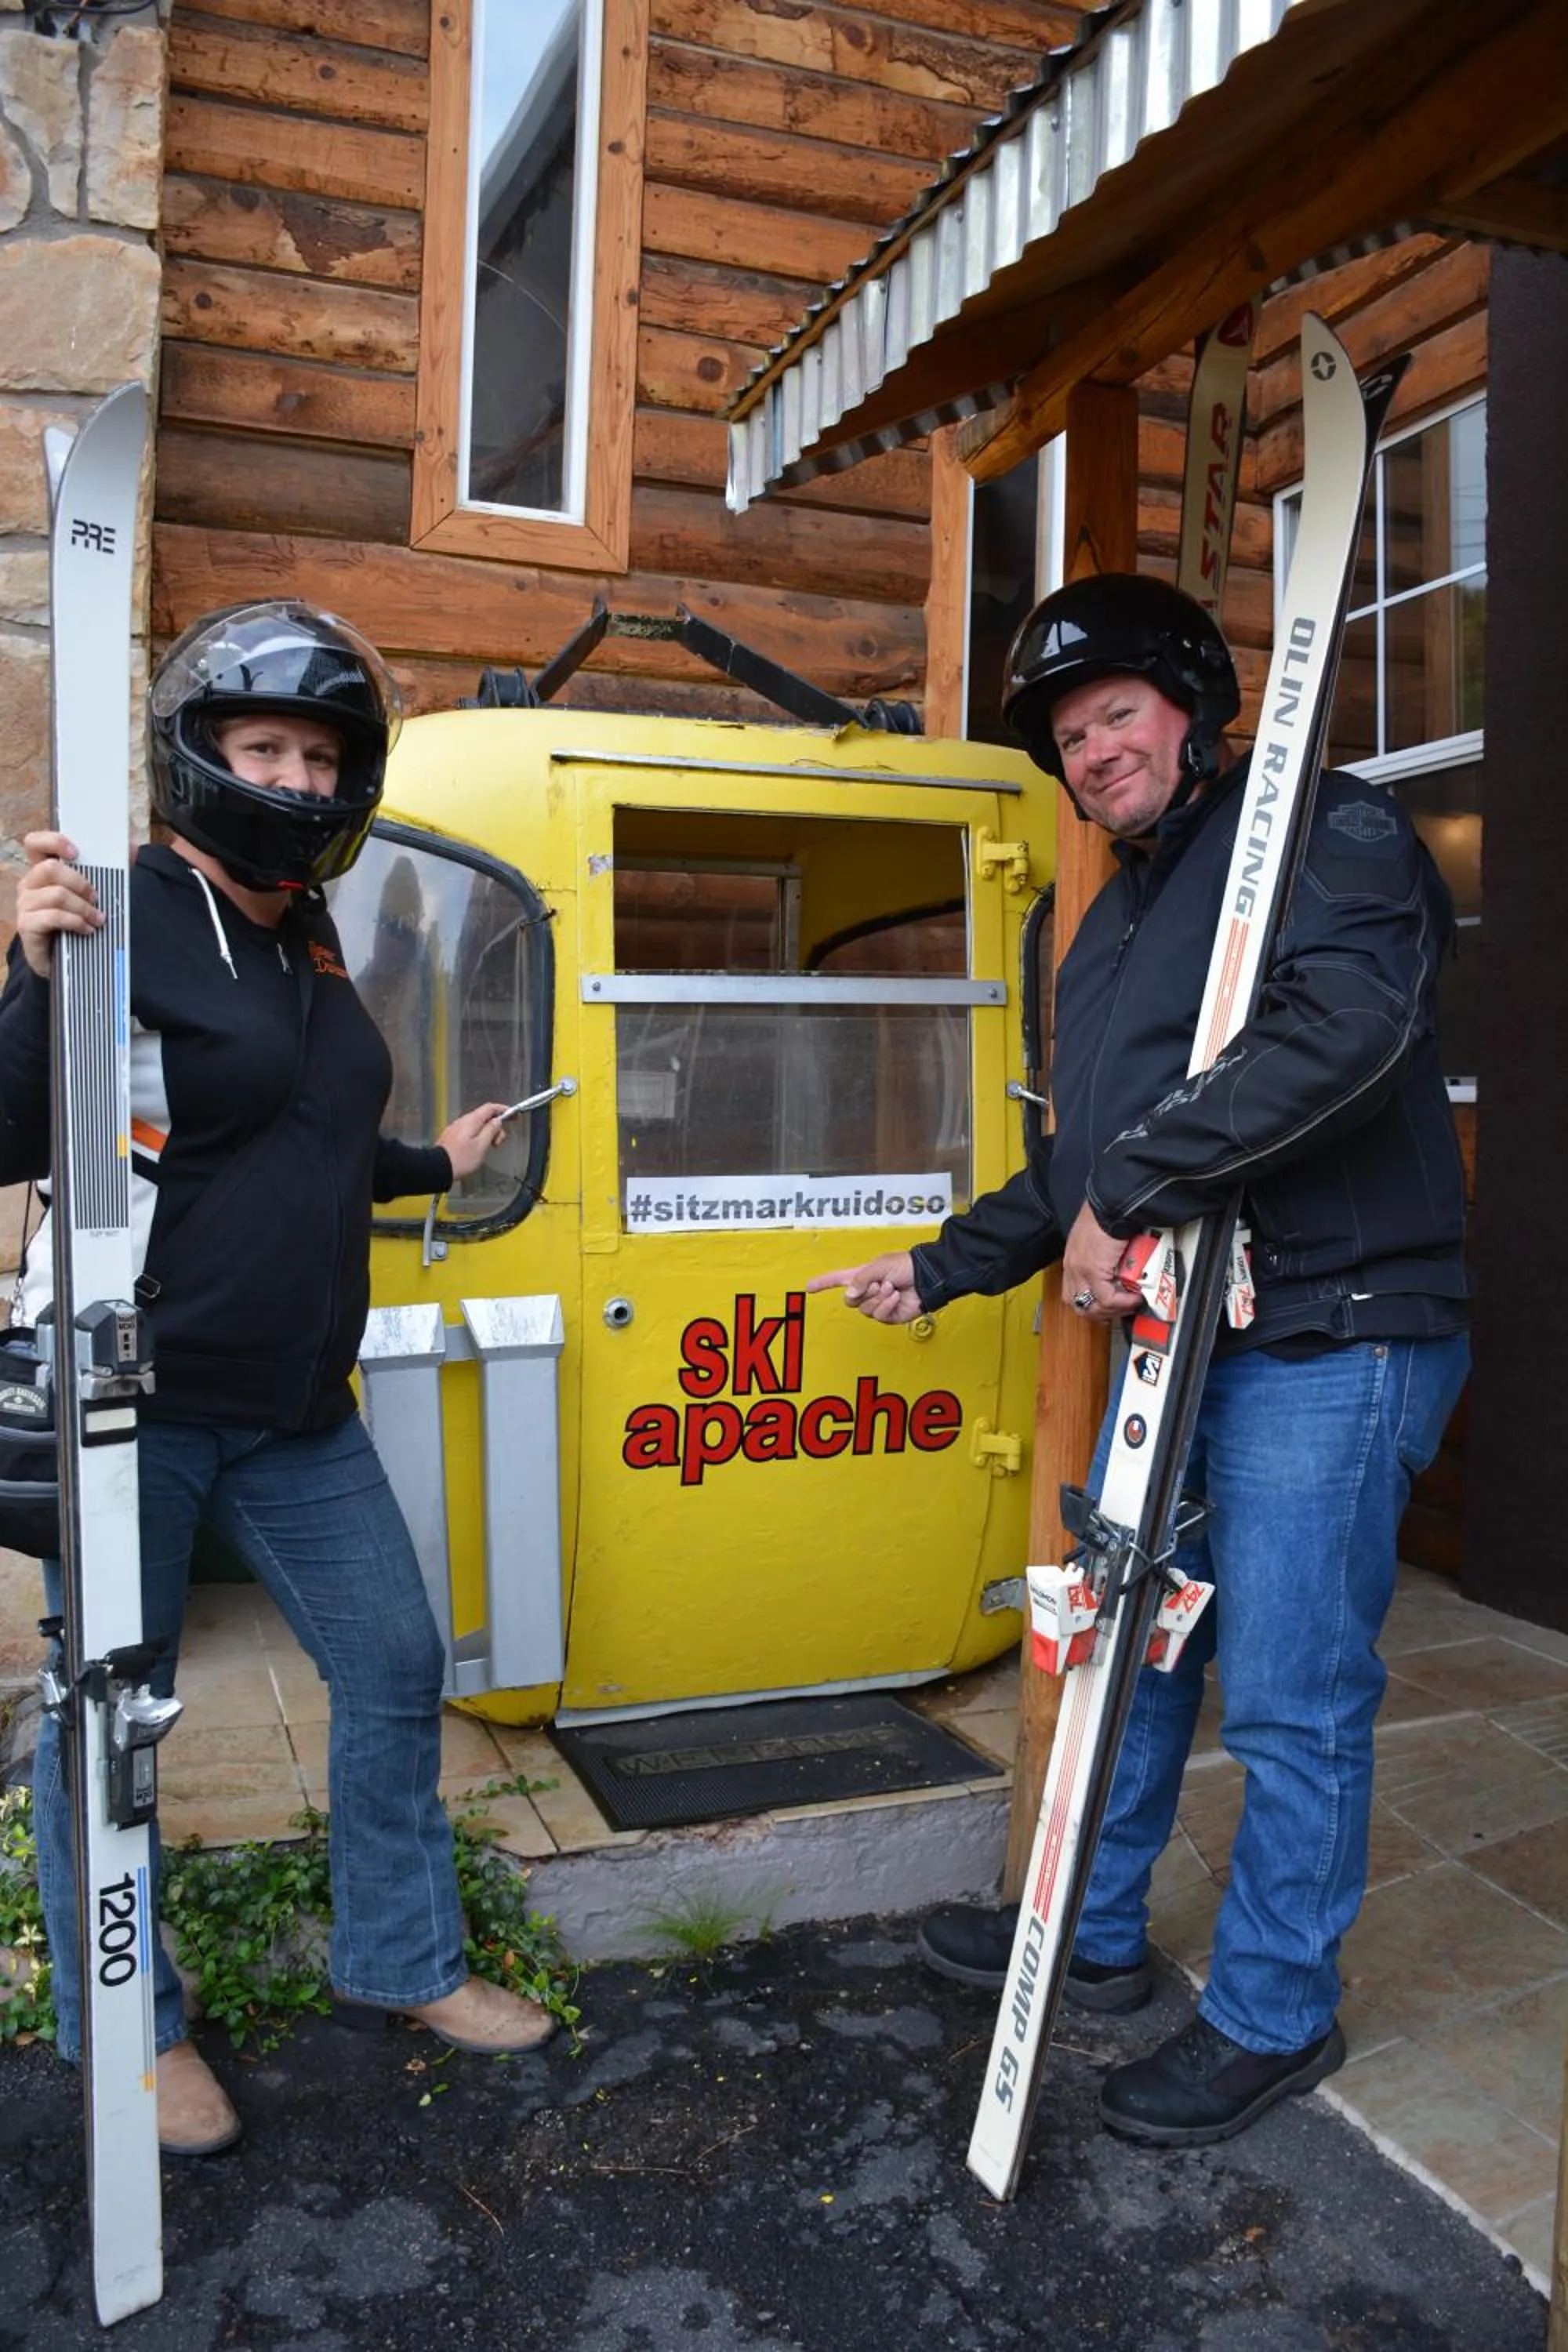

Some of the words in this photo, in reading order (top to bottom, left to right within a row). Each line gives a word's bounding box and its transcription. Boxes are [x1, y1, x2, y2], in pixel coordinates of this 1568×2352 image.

[71, 519, 116, 554] PRE
[1200, 401, 1233, 608] STAR
[1273, 617, 1316, 728] OLIN
[1234, 743, 1288, 918] RACING
[630, 1190, 946, 1221] #sitzmarkruidoso
[678, 1291, 806, 1398] ski
[622, 1376, 962, 1486] apache
[99, 1872, 136, 1987] 1200
[1011, 1915, 1045, 2042] COMP
[995, 2046, 1019, 2113] GS
